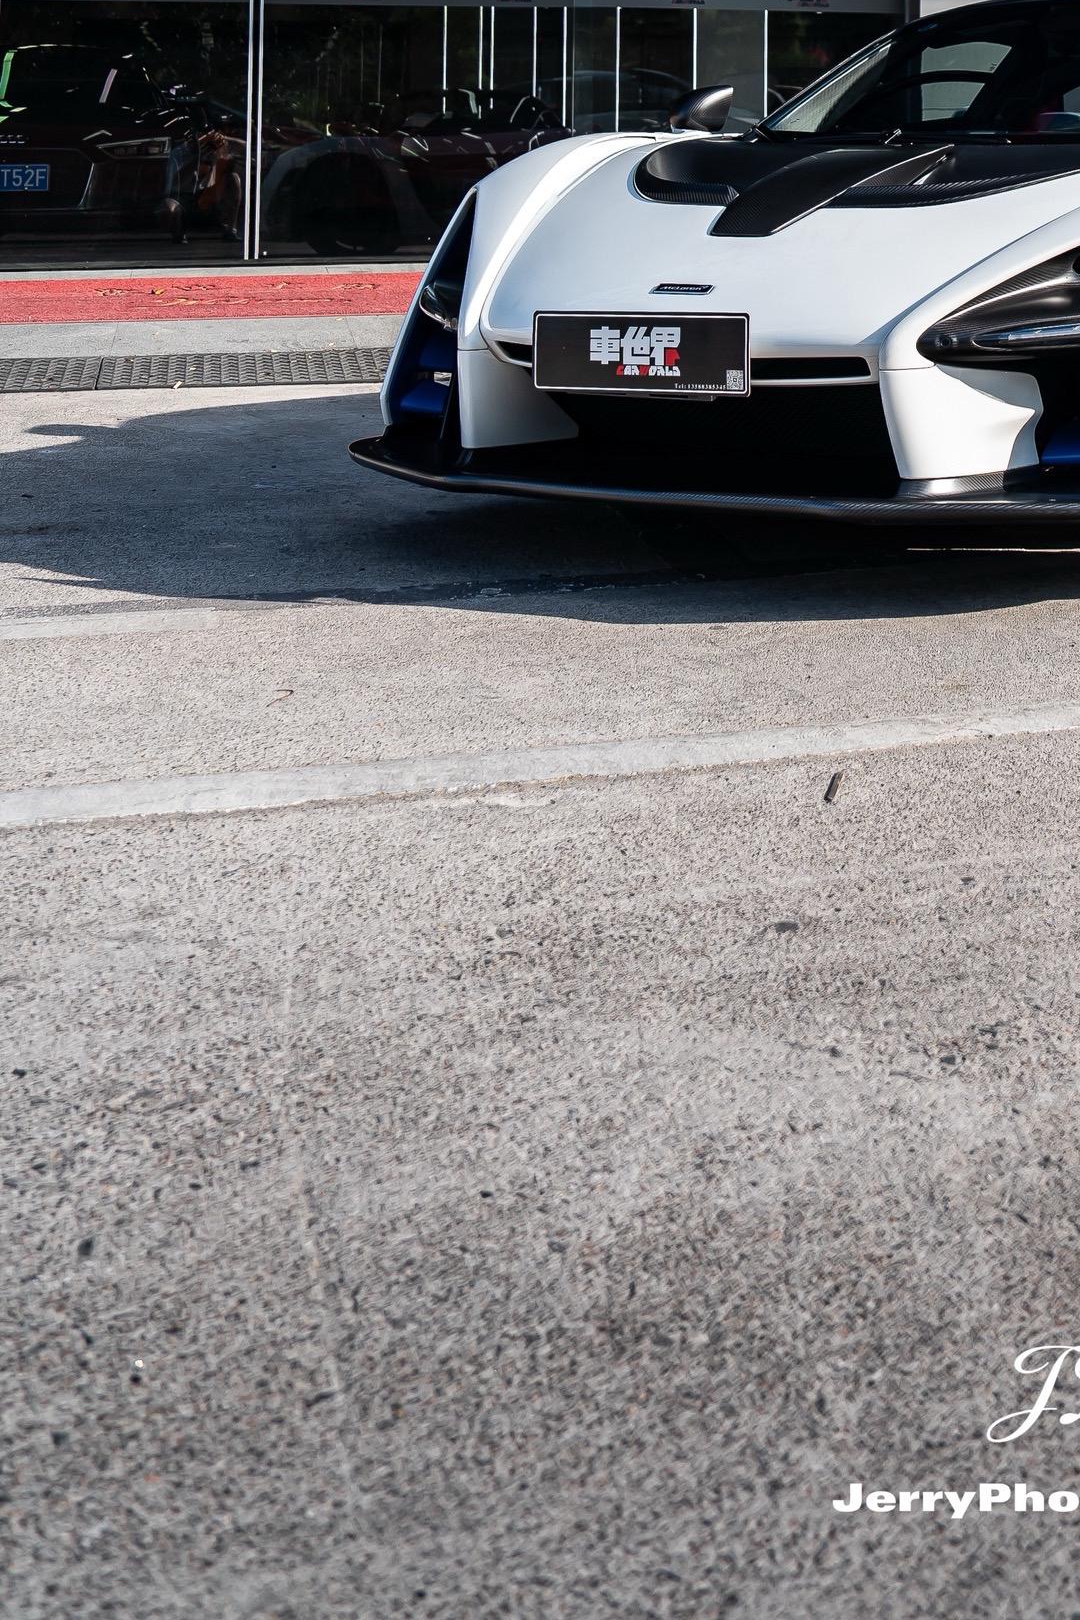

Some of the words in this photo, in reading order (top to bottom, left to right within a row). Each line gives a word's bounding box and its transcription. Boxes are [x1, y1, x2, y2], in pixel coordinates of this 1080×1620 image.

[1, 168, 47, 187] T52F
[589, 325, 681, 366] 車世界
